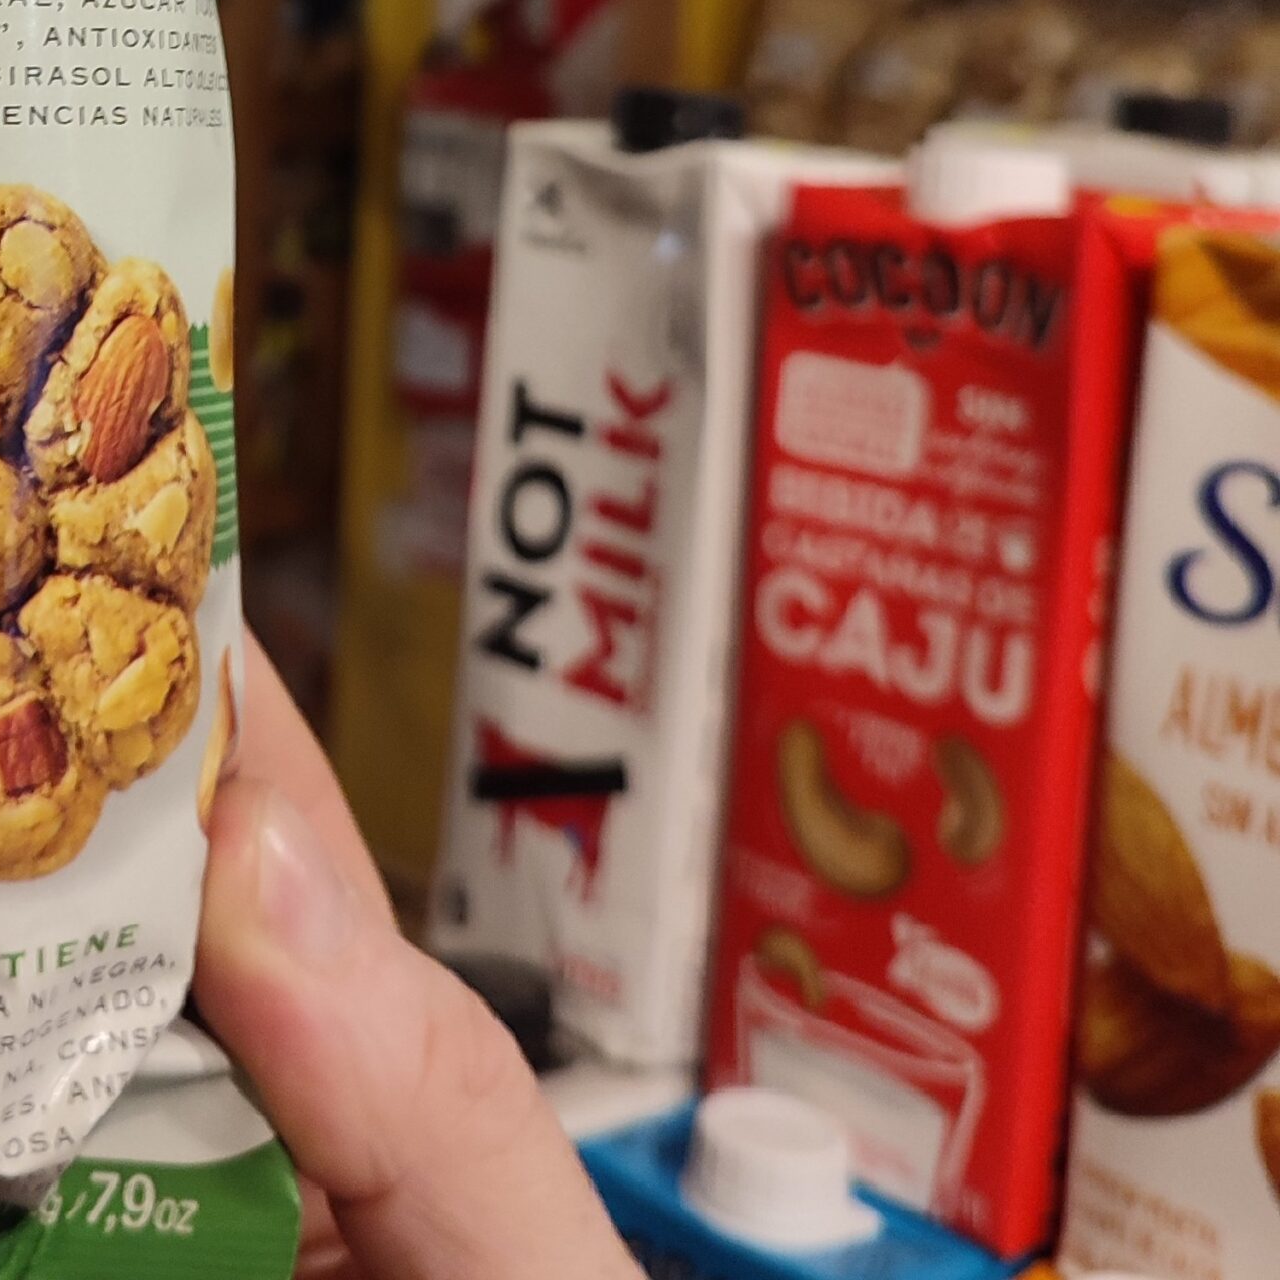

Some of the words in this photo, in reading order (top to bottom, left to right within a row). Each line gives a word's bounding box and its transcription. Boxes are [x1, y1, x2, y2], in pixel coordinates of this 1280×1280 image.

[477, 378, 585, 672] NOT
[561, 368, 677, 708] MILK
[1164, 458, 1280, 629] S
[754, 565, 1034, 727] CAJU
